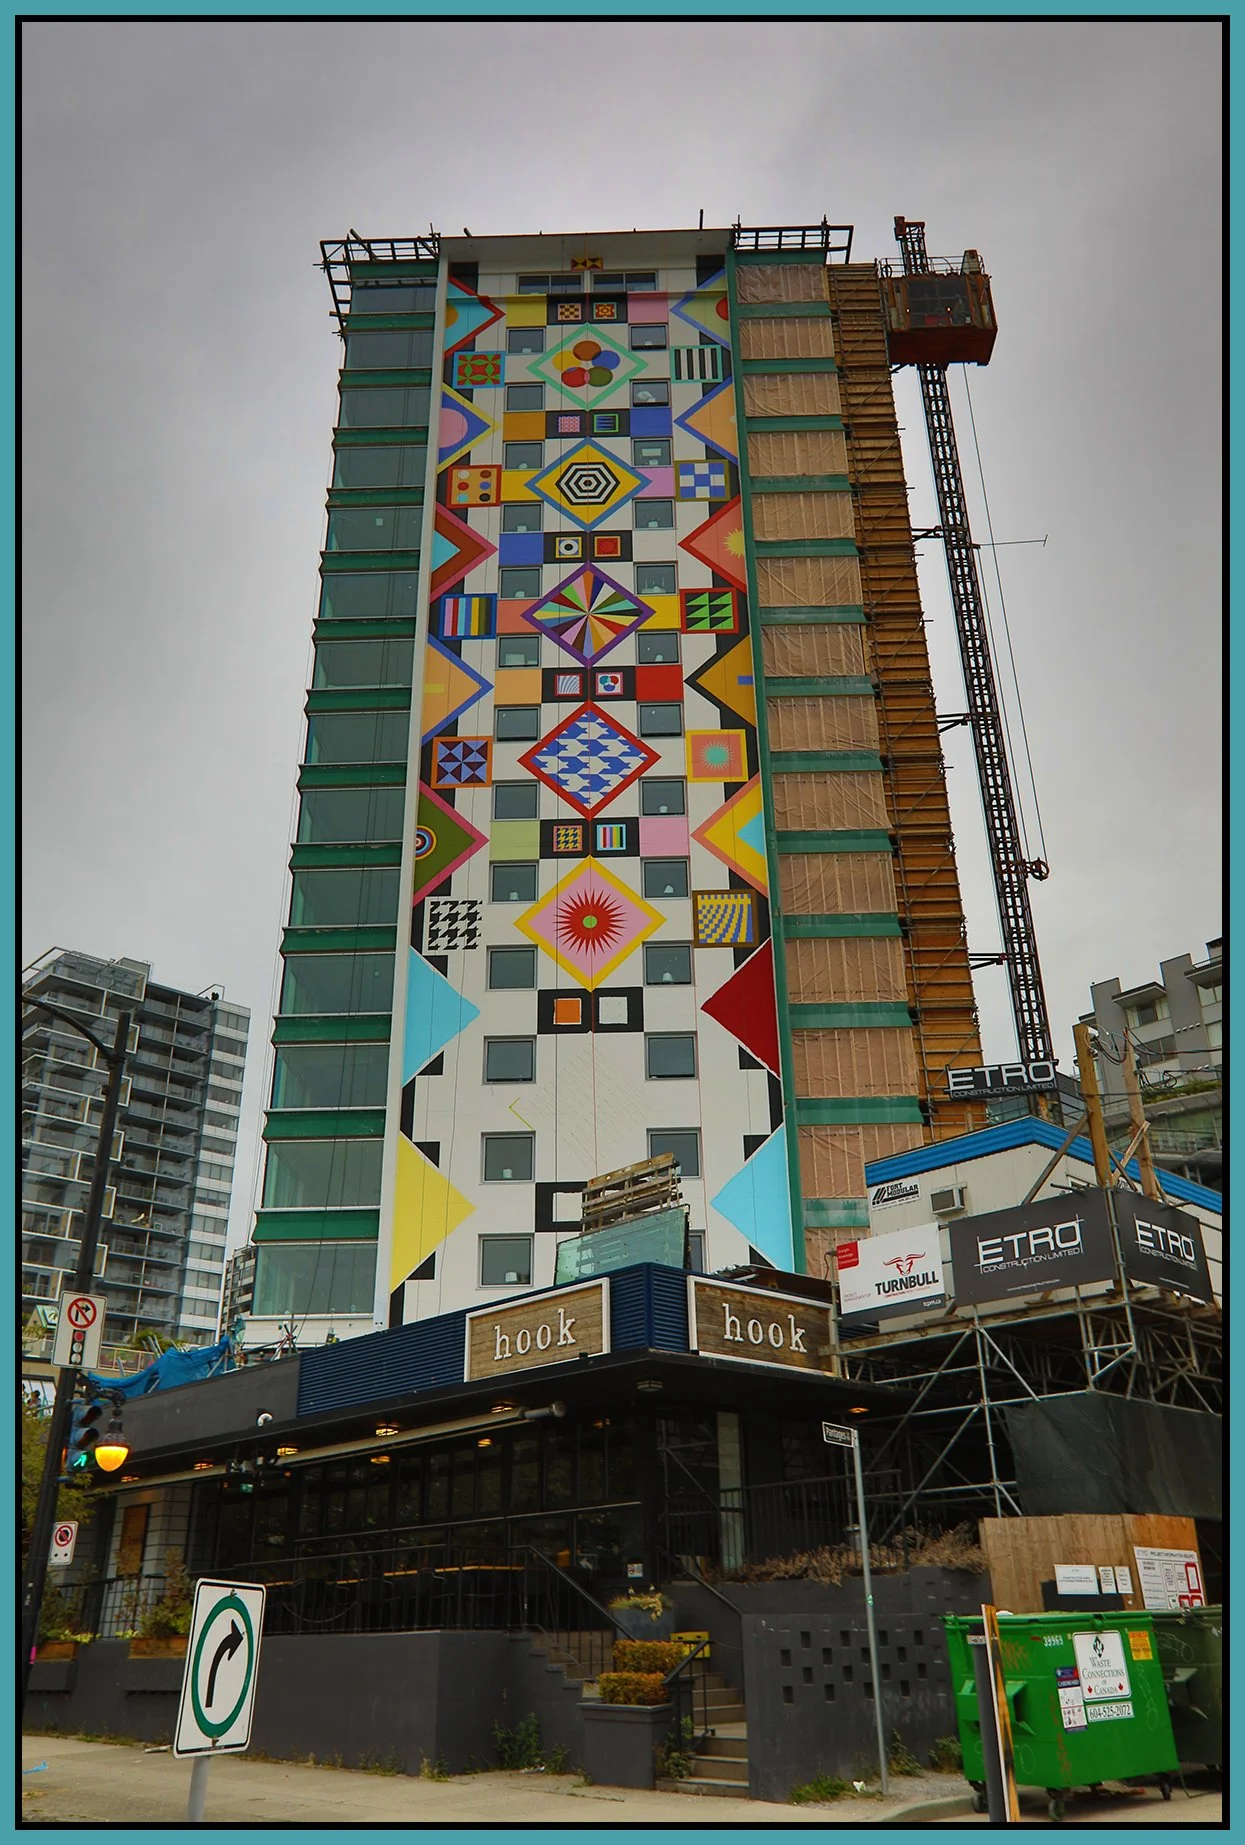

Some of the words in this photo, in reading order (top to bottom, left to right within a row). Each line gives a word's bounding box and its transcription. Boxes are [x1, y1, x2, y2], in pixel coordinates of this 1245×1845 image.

[947, 1060, 1056, 1091] ETRO
[953, 1086, 1019, 1098] CONSTRUCTION
[1021, 1082, 1054, 1092] LIMITED
[886, 1182, 903, 1192] FORT
[886, 1184, 919, 1197] MODULAR
[978, 1220, 1081, 1265] ETRO
[1135, 1219, 1195, 1262] ETRO
[983, 1253, 1047, 1273] CONSTRUCTION
[1047, 1247, 1080, 1260] LIMITED
[875, 1271, 939, 1295] TURNBULL
[493, 1308, 577, 1361] hook
[722, 1302, 807, 1353] hook
[1089, 1657, 1112, 1668] WASTE
[1082, 1668, 1125, 1680] CONNECTIONS
[1094, 1684, 1118, 1696] CANADA
[1089, 1704, 1132, 1719] 604-525-2072
